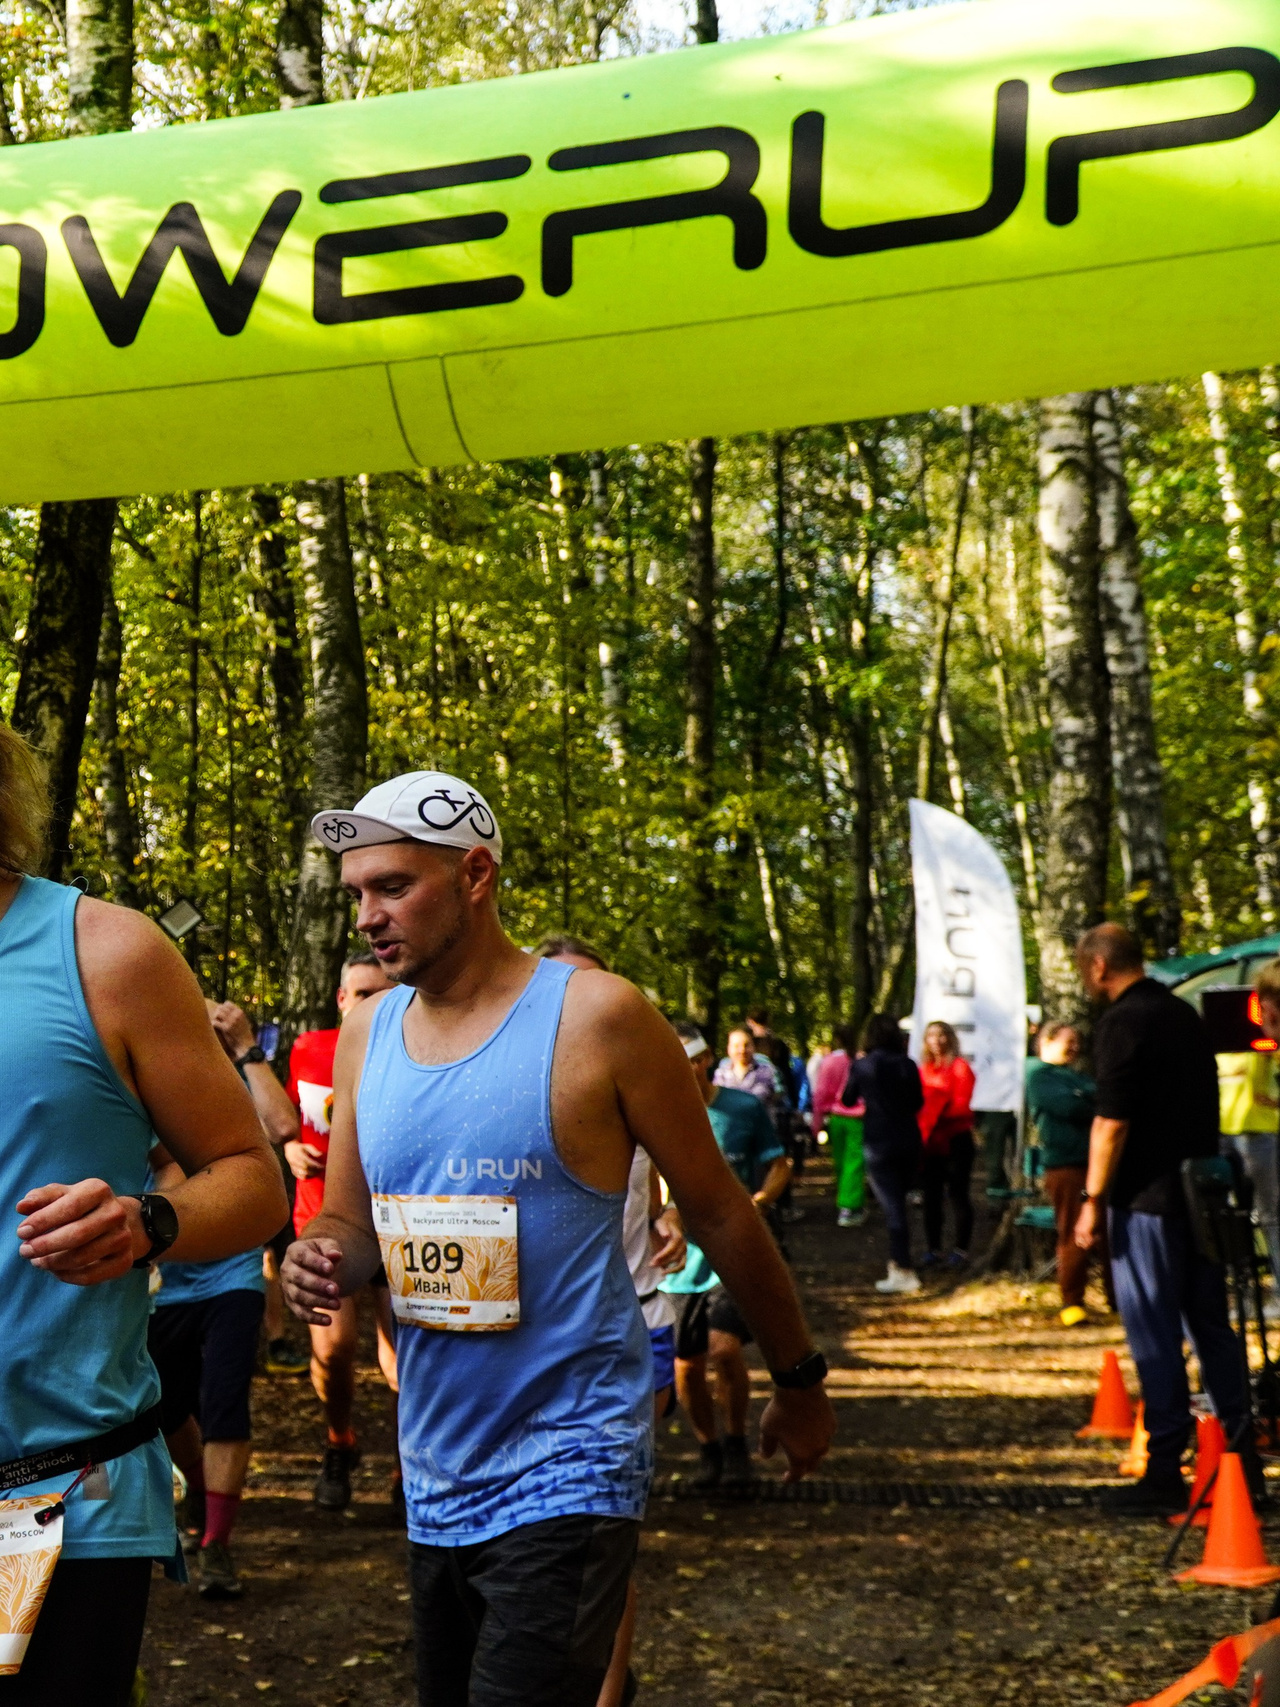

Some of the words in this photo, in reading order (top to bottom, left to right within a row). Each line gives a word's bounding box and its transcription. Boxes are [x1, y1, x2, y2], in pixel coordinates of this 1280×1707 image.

[447, 1158, 467, 1180] U
[477, 1158, 542, 1180] RUN
[403, 1241, 464, 1274] 109
[413, 1278, 451, 1294] Иван
[5, 1452, 75, 1480] anti-shock
[10, 1528, 45, 1540] Moscow
